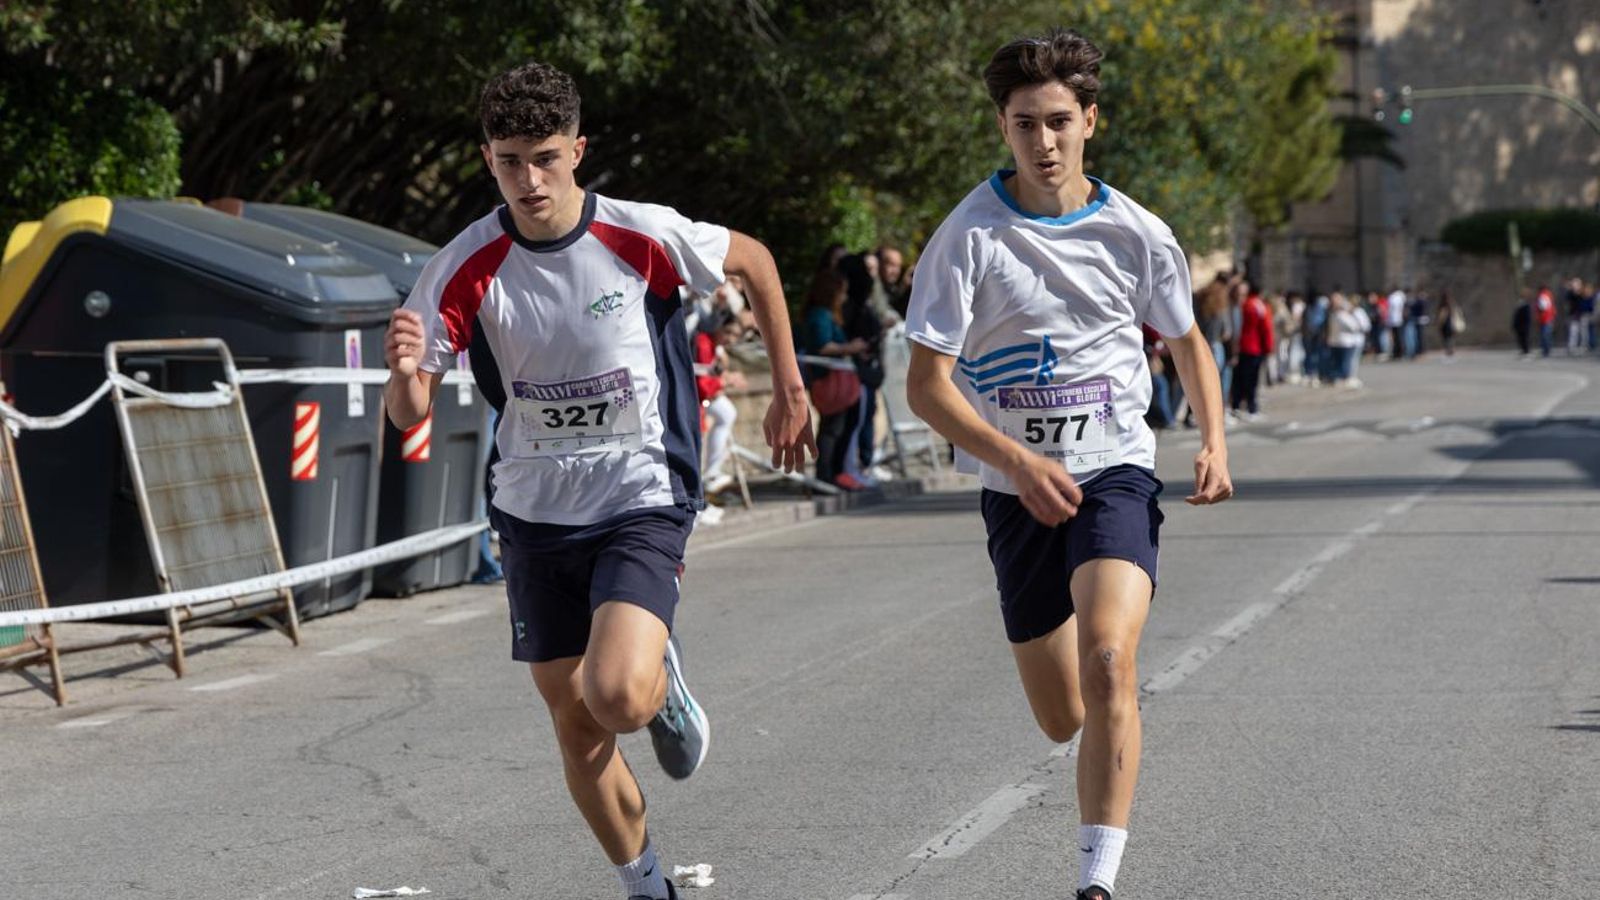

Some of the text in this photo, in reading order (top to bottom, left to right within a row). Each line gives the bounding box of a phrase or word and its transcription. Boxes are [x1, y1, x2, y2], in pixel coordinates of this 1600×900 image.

[577, 388, 586, 396] LA
[1057, 387, 1083, 397] CARRERA
[1083, 384, 1107, 394] ESCOLAR
[1062, 392, 1101, 404] LA GLORIA
[541, 402, 609, 429] 327
[1024, 414, 1089, 444] 577
